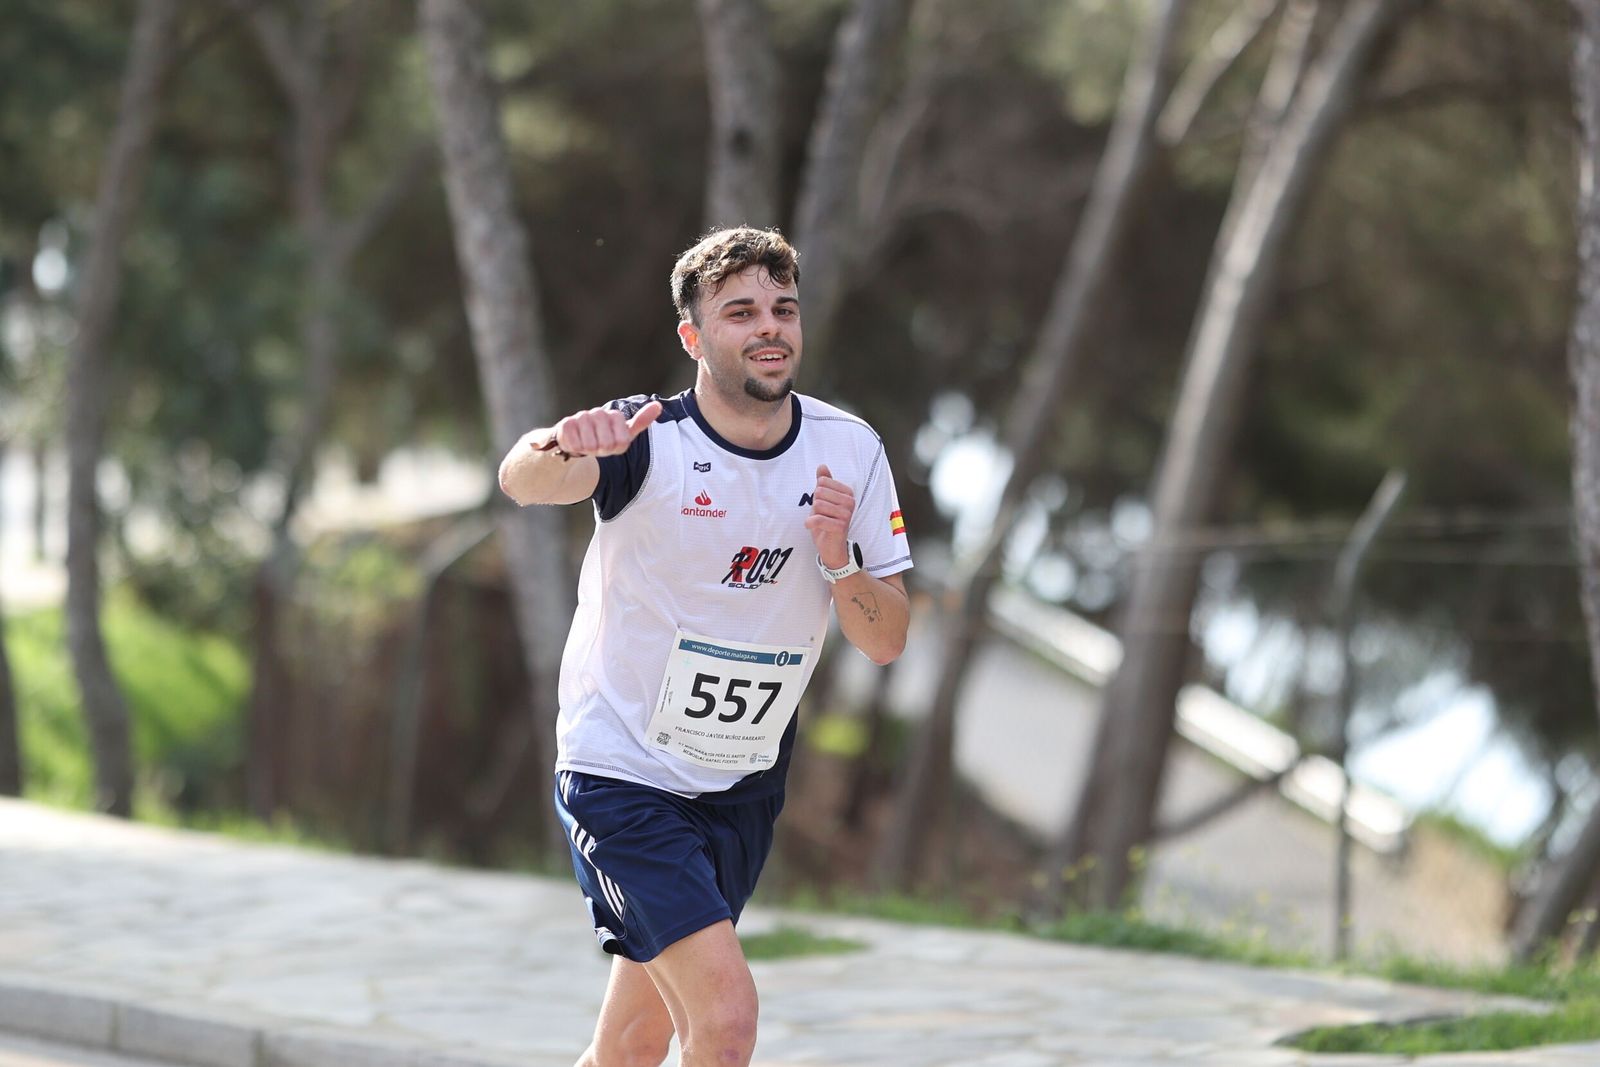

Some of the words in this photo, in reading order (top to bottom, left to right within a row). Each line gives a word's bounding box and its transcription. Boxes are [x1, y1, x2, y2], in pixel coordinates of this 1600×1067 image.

[684, 672, 783, 725] 557
[675, 726, 705, 737] FRANCISCO
[705, 731, 724, 739] JAVIER
